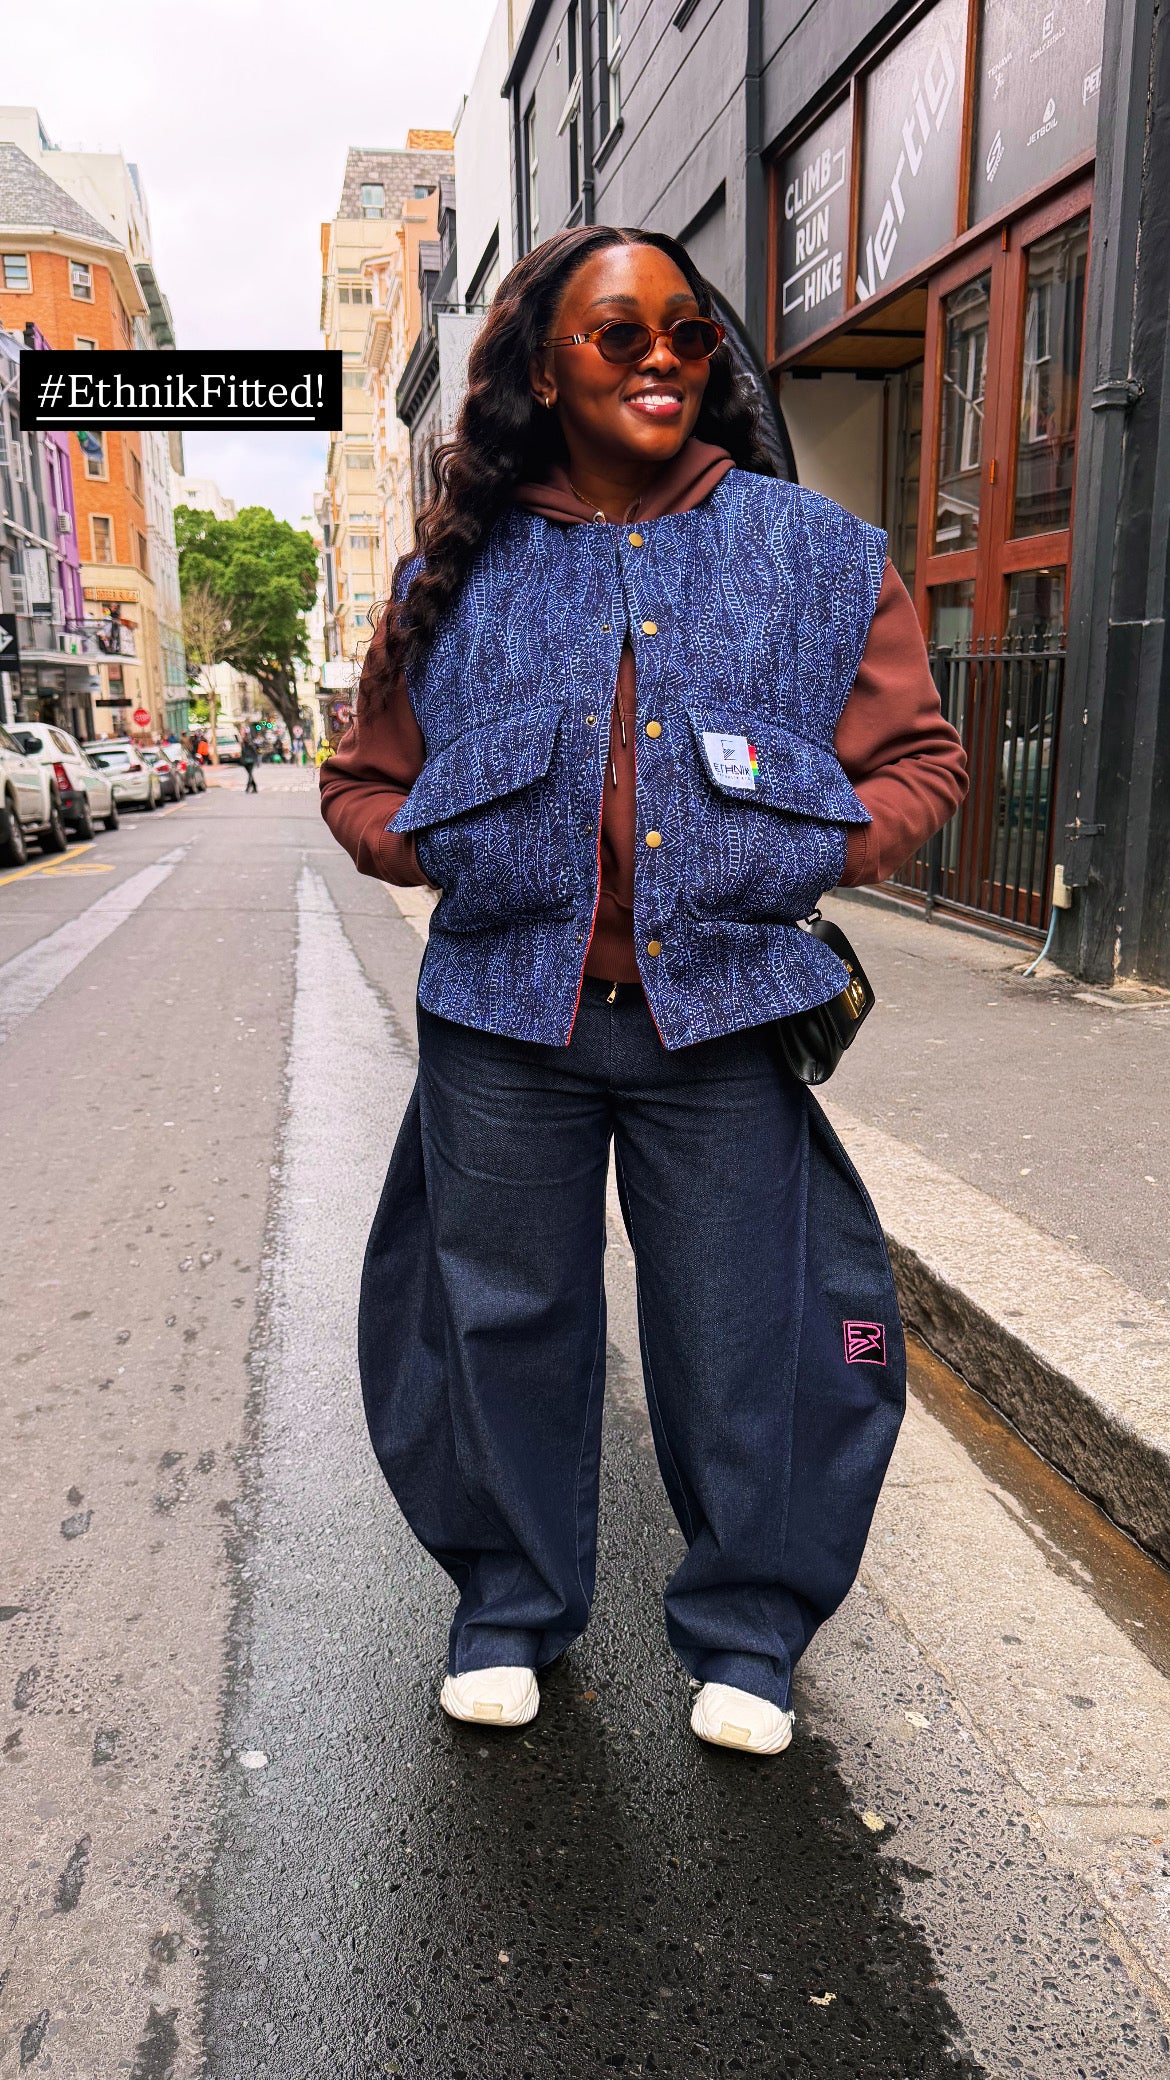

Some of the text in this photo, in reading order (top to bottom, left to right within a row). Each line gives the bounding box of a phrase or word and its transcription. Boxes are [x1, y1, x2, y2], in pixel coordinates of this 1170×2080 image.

[1026, 117, 1058, 147] JETBOIL
[785, 148, 831, 221] CLIMB
[795, 204, 830, 266] RUN
[804, 251, 842, 313] HIKE
